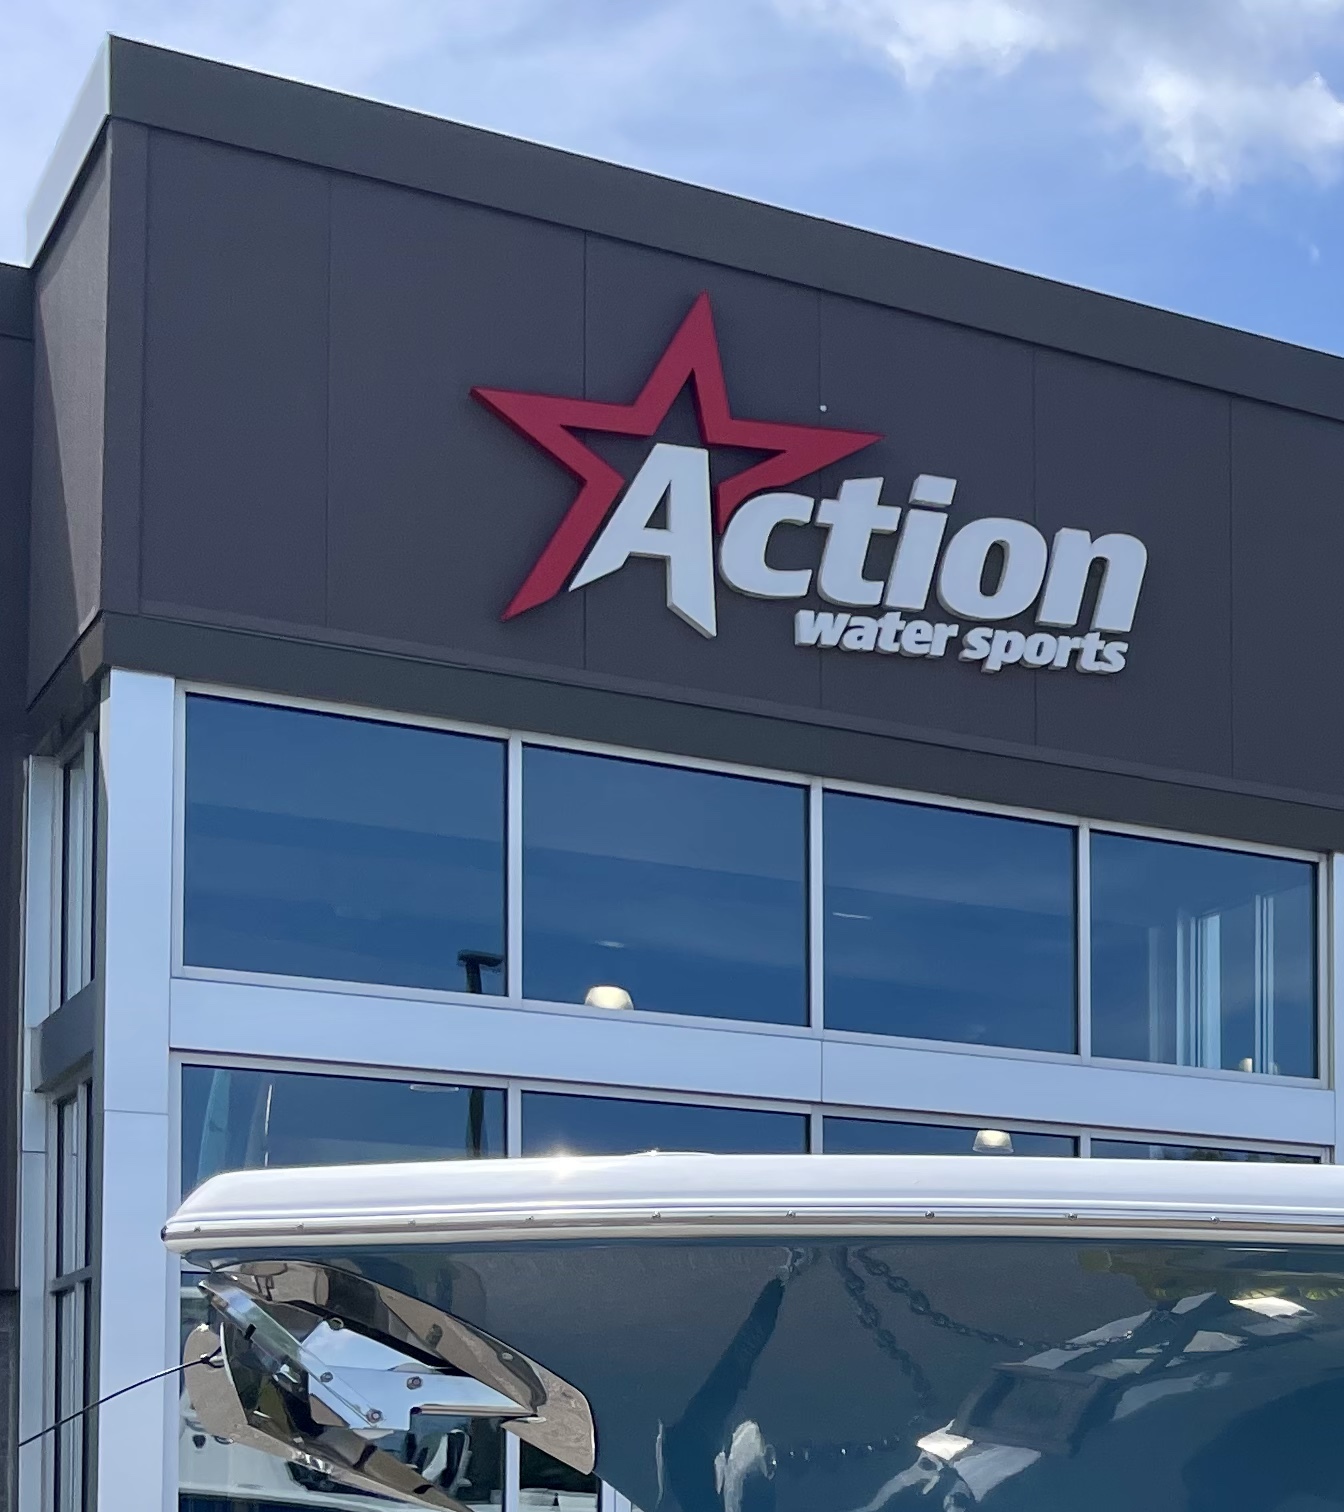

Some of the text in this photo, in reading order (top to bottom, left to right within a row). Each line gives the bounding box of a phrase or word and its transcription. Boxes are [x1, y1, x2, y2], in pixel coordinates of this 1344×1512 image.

[569, 442, 1149, 638] Action
[795, 609, 1129, 674] water sports
